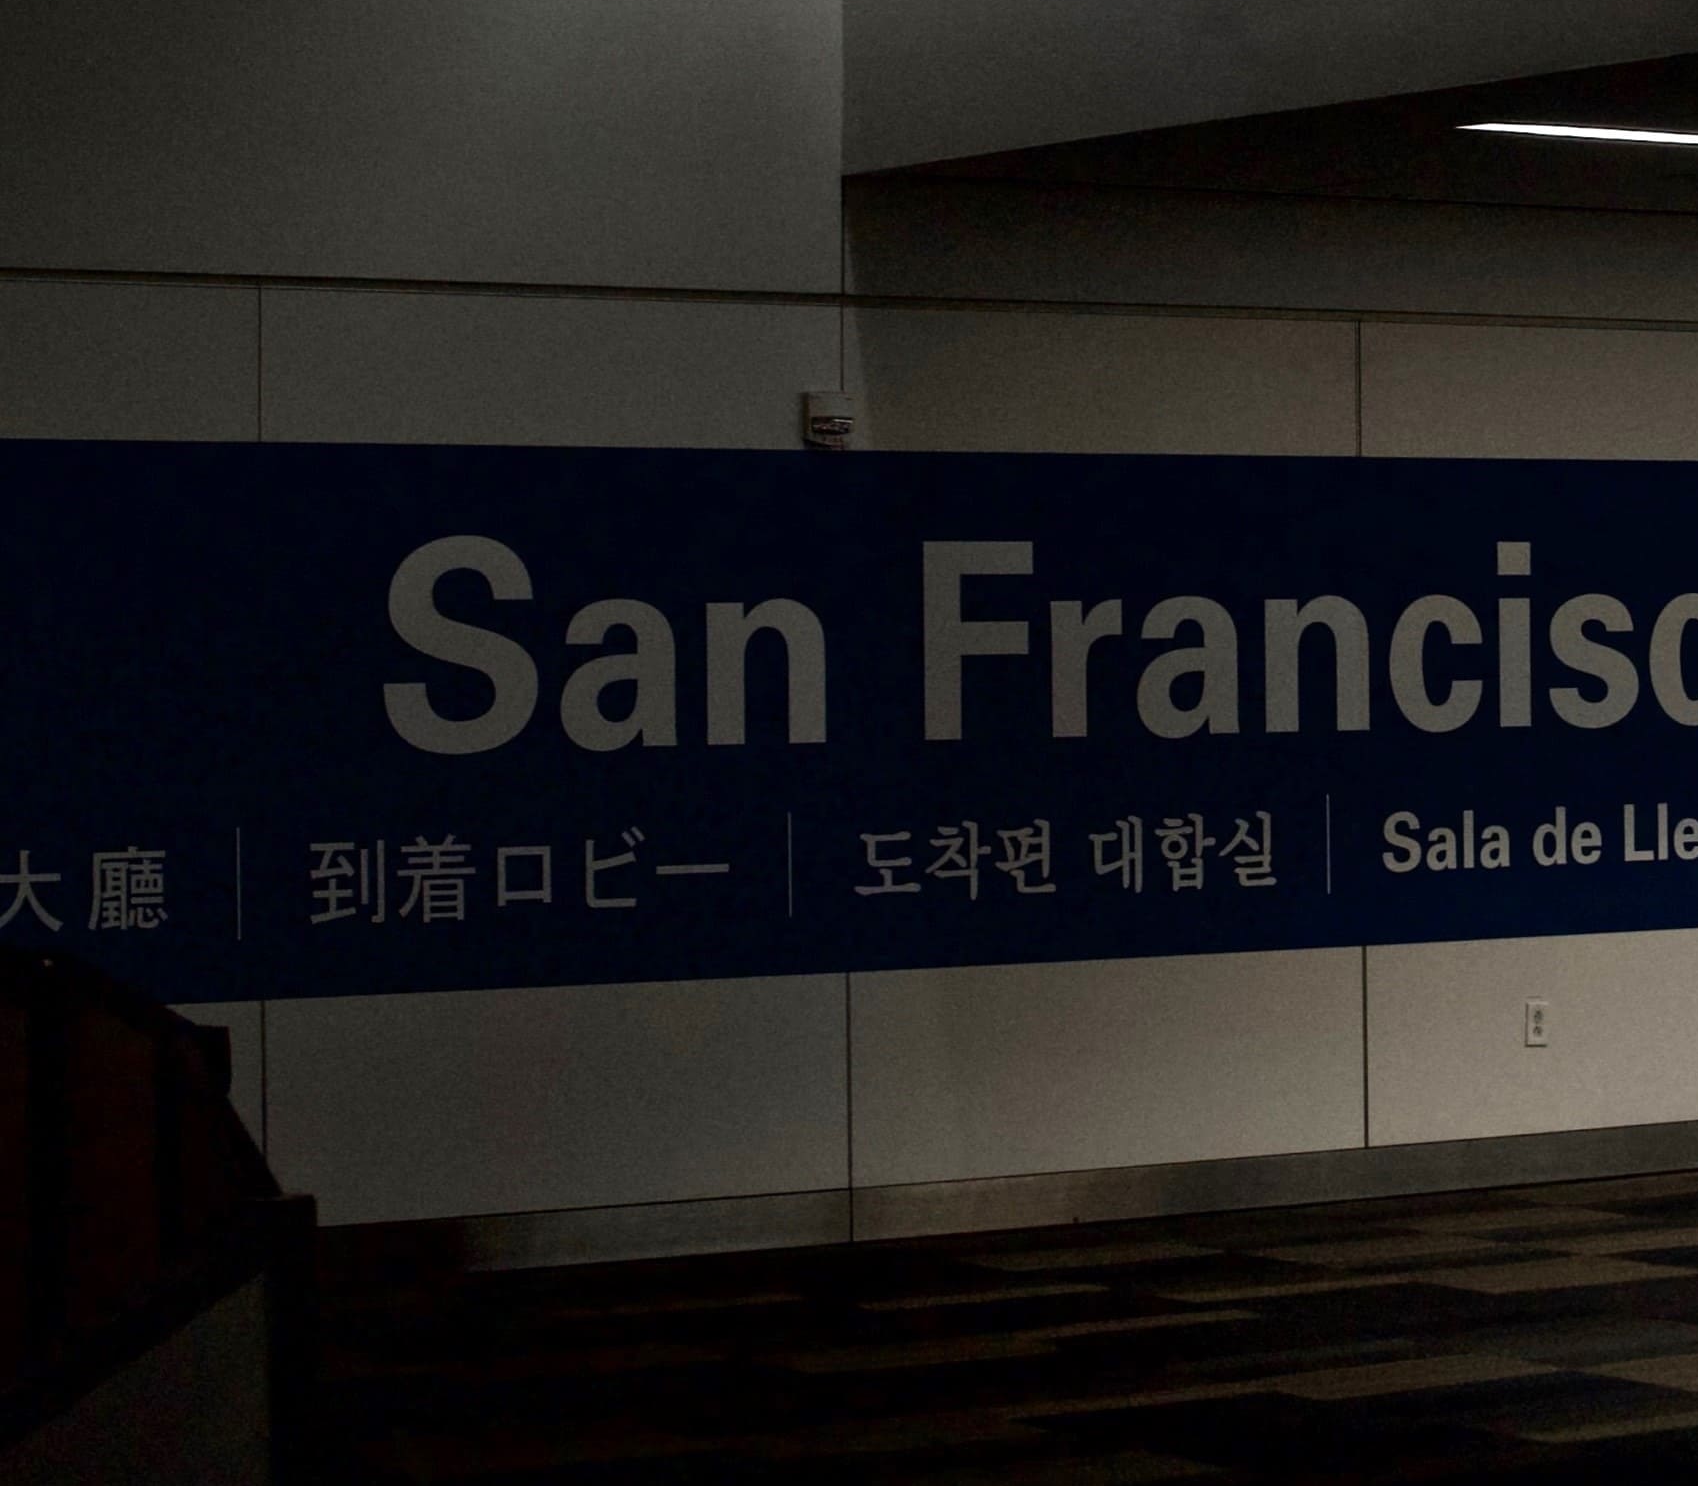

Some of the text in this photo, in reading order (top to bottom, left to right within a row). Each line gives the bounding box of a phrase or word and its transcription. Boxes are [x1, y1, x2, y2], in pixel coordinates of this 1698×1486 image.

[382, 533, 828, 756] San
[308, 825, 731, 924] 到着ロビー
[853, 810, 1277, 901] 도착편 대합실
[1382, 810, 1511, 873] Sala
[1532, 806, 1603, 866] de
[0, 845, 168, 931] 大廳
